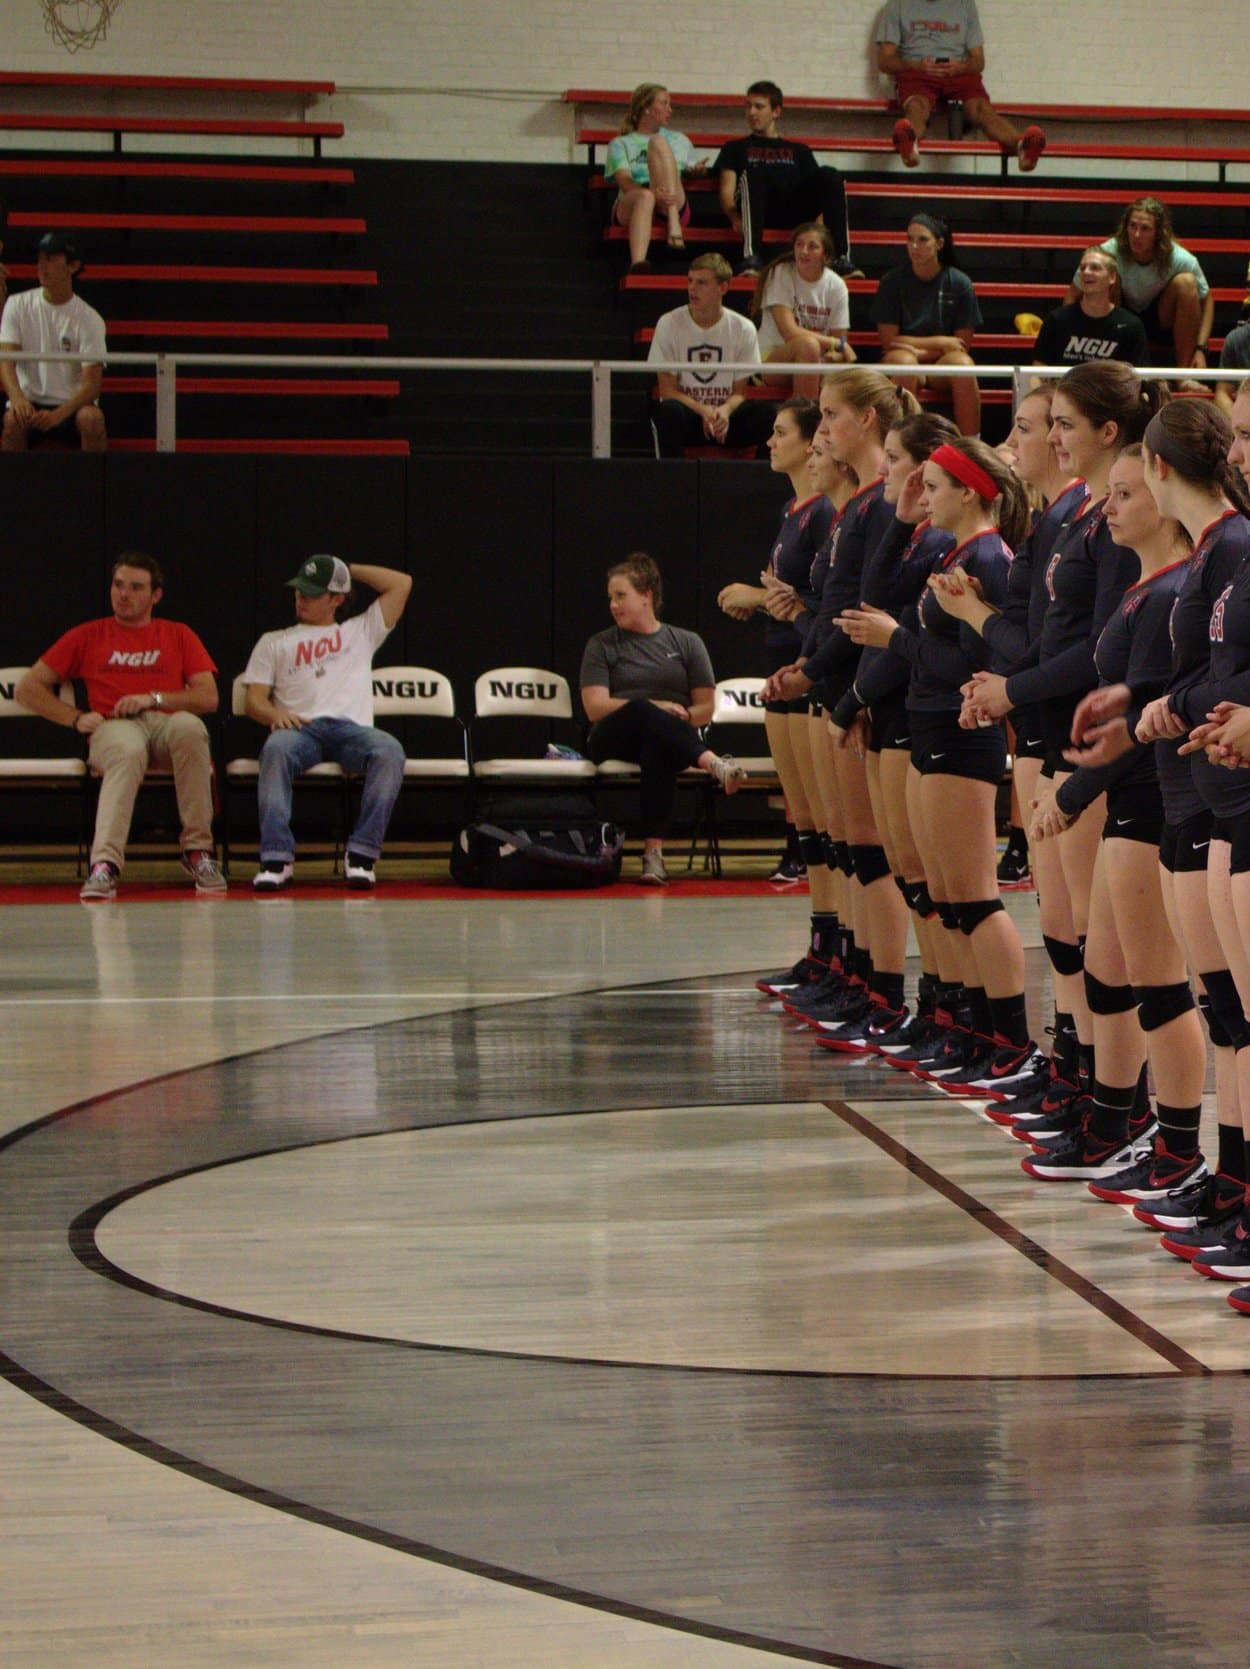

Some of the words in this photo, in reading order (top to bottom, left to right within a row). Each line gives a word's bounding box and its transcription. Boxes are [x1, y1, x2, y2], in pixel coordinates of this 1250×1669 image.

[1064, 335, 1119, 358] NGU
[107, 650, 161, 667] NGU
[372, 680, 440, 699] NGU
[489, 680, 558, 701] NGU
[723, 689, 768, 708] NG
